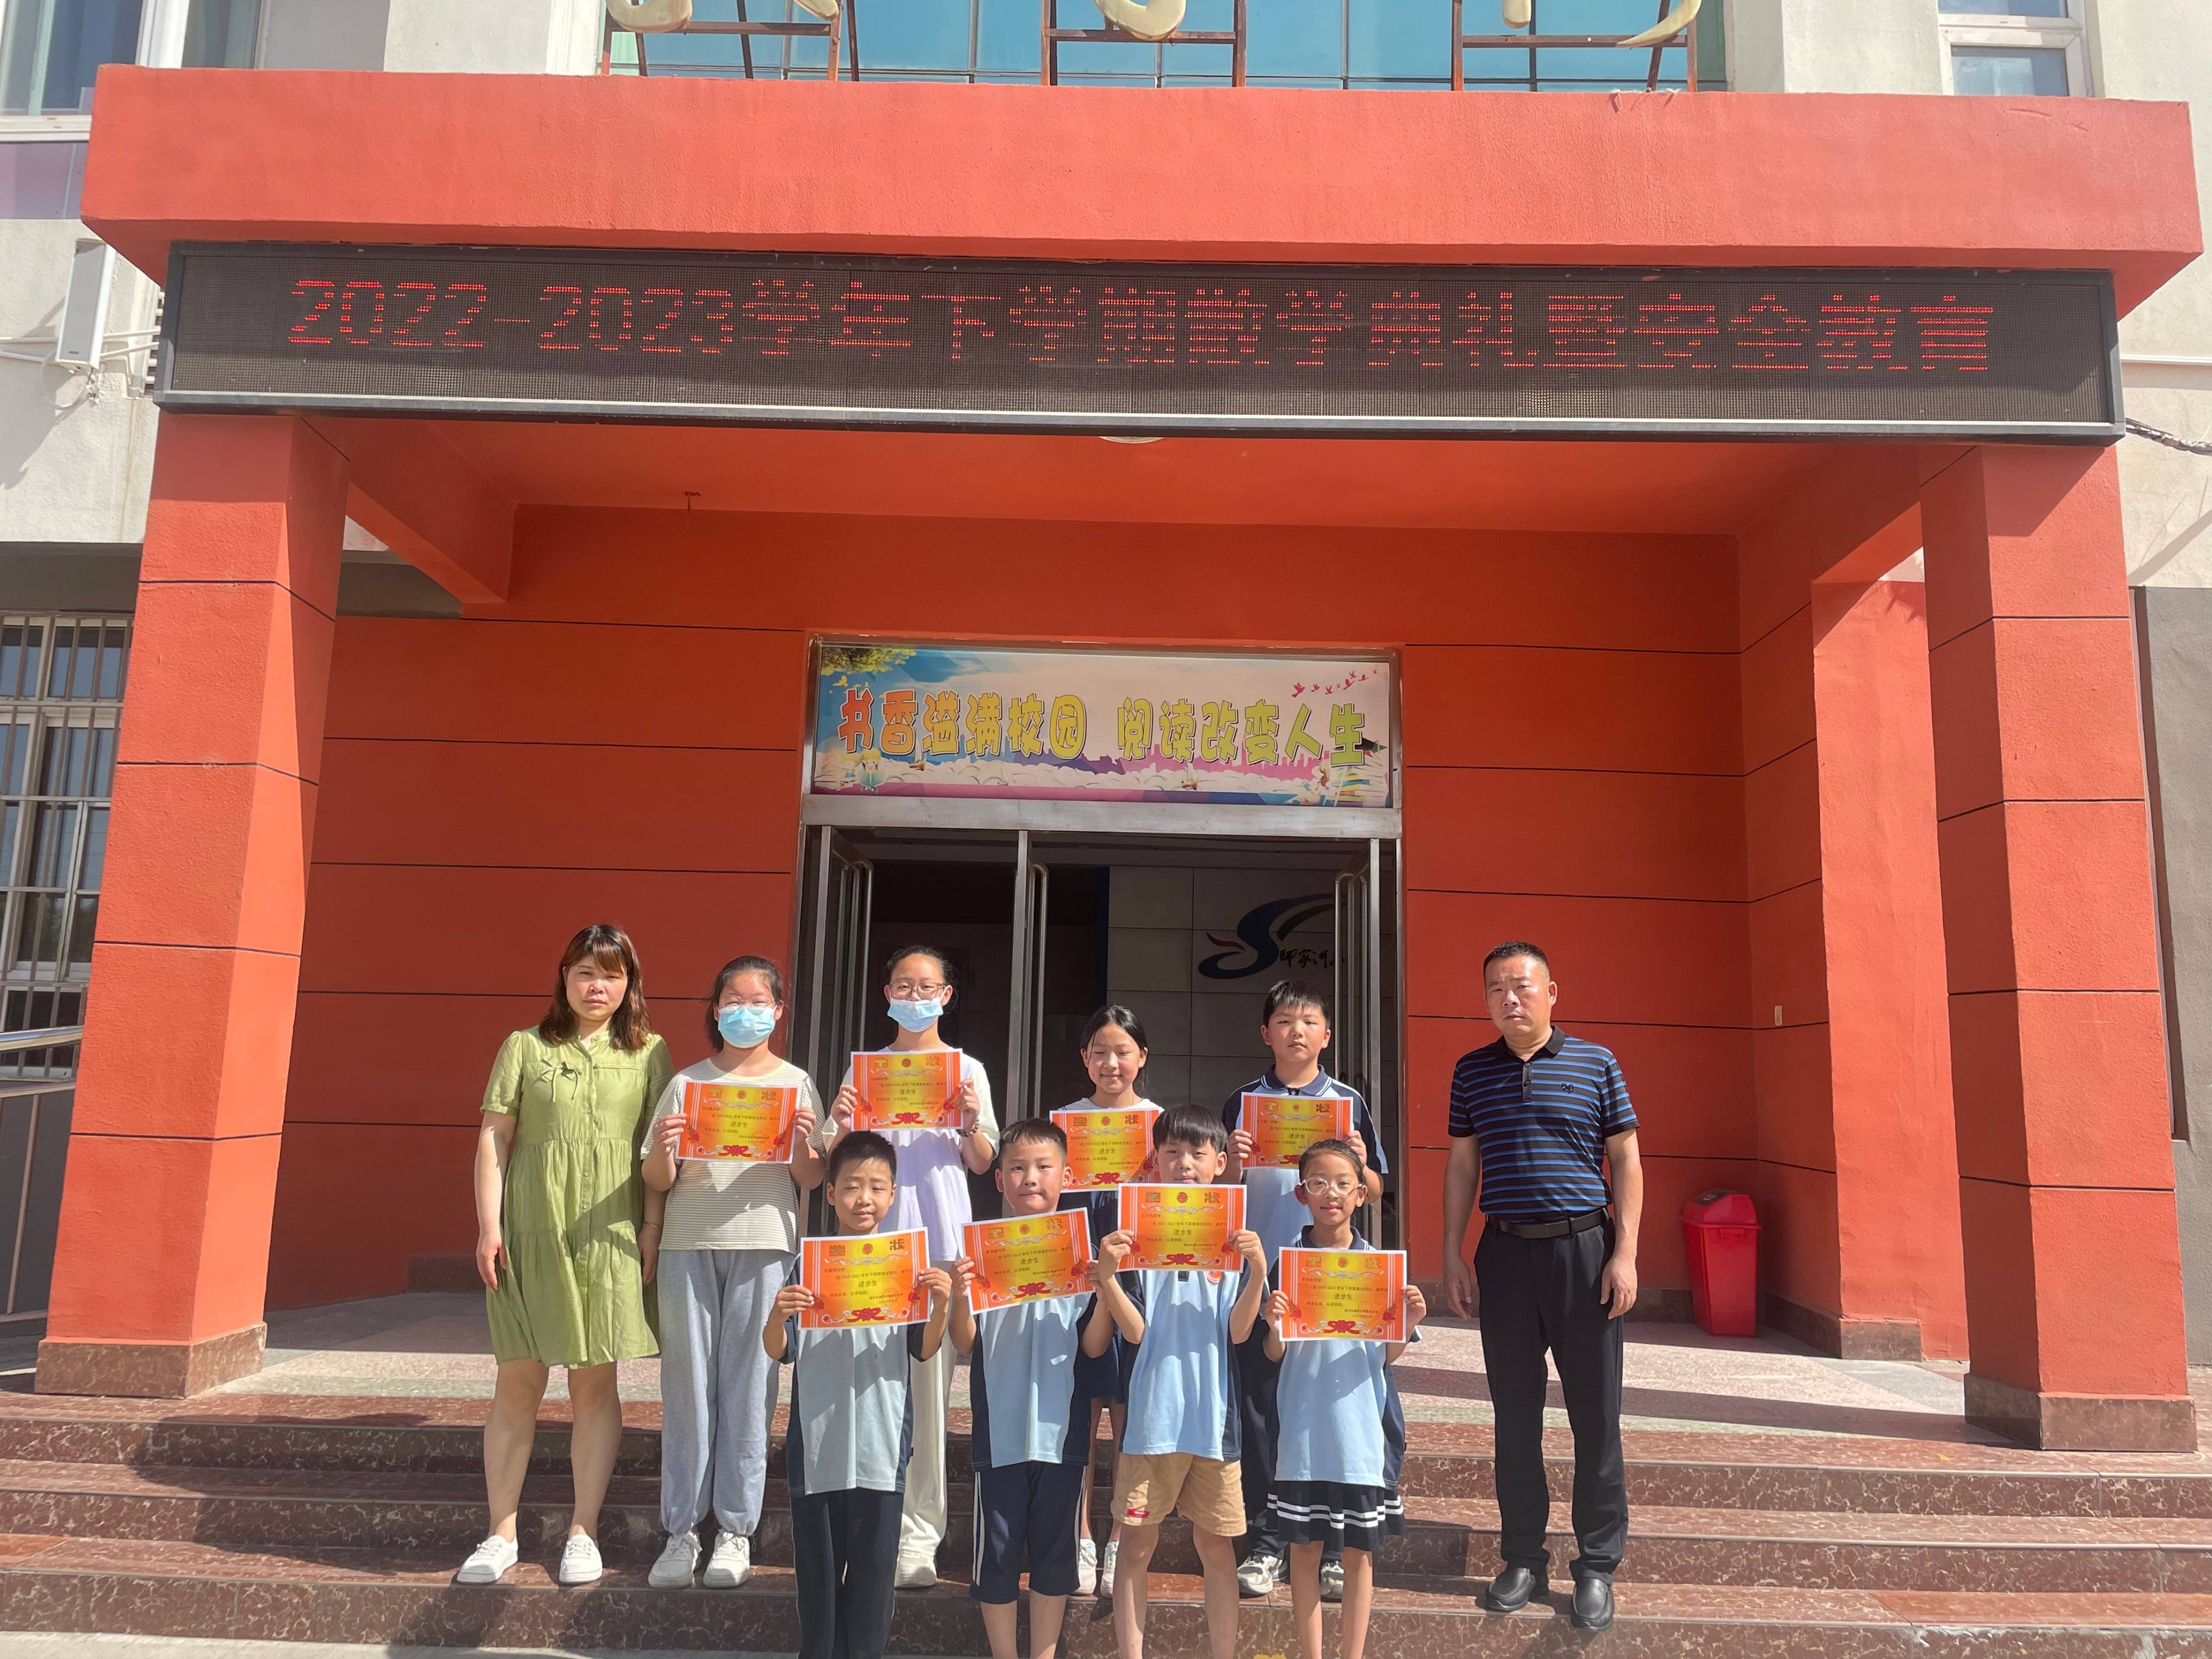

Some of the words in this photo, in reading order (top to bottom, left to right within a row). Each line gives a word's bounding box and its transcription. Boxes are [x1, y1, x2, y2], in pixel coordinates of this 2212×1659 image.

[838, 688, 1087, 760] 书香溢满校园
[1118, 696, 1365, 767] 阅读改变人生
